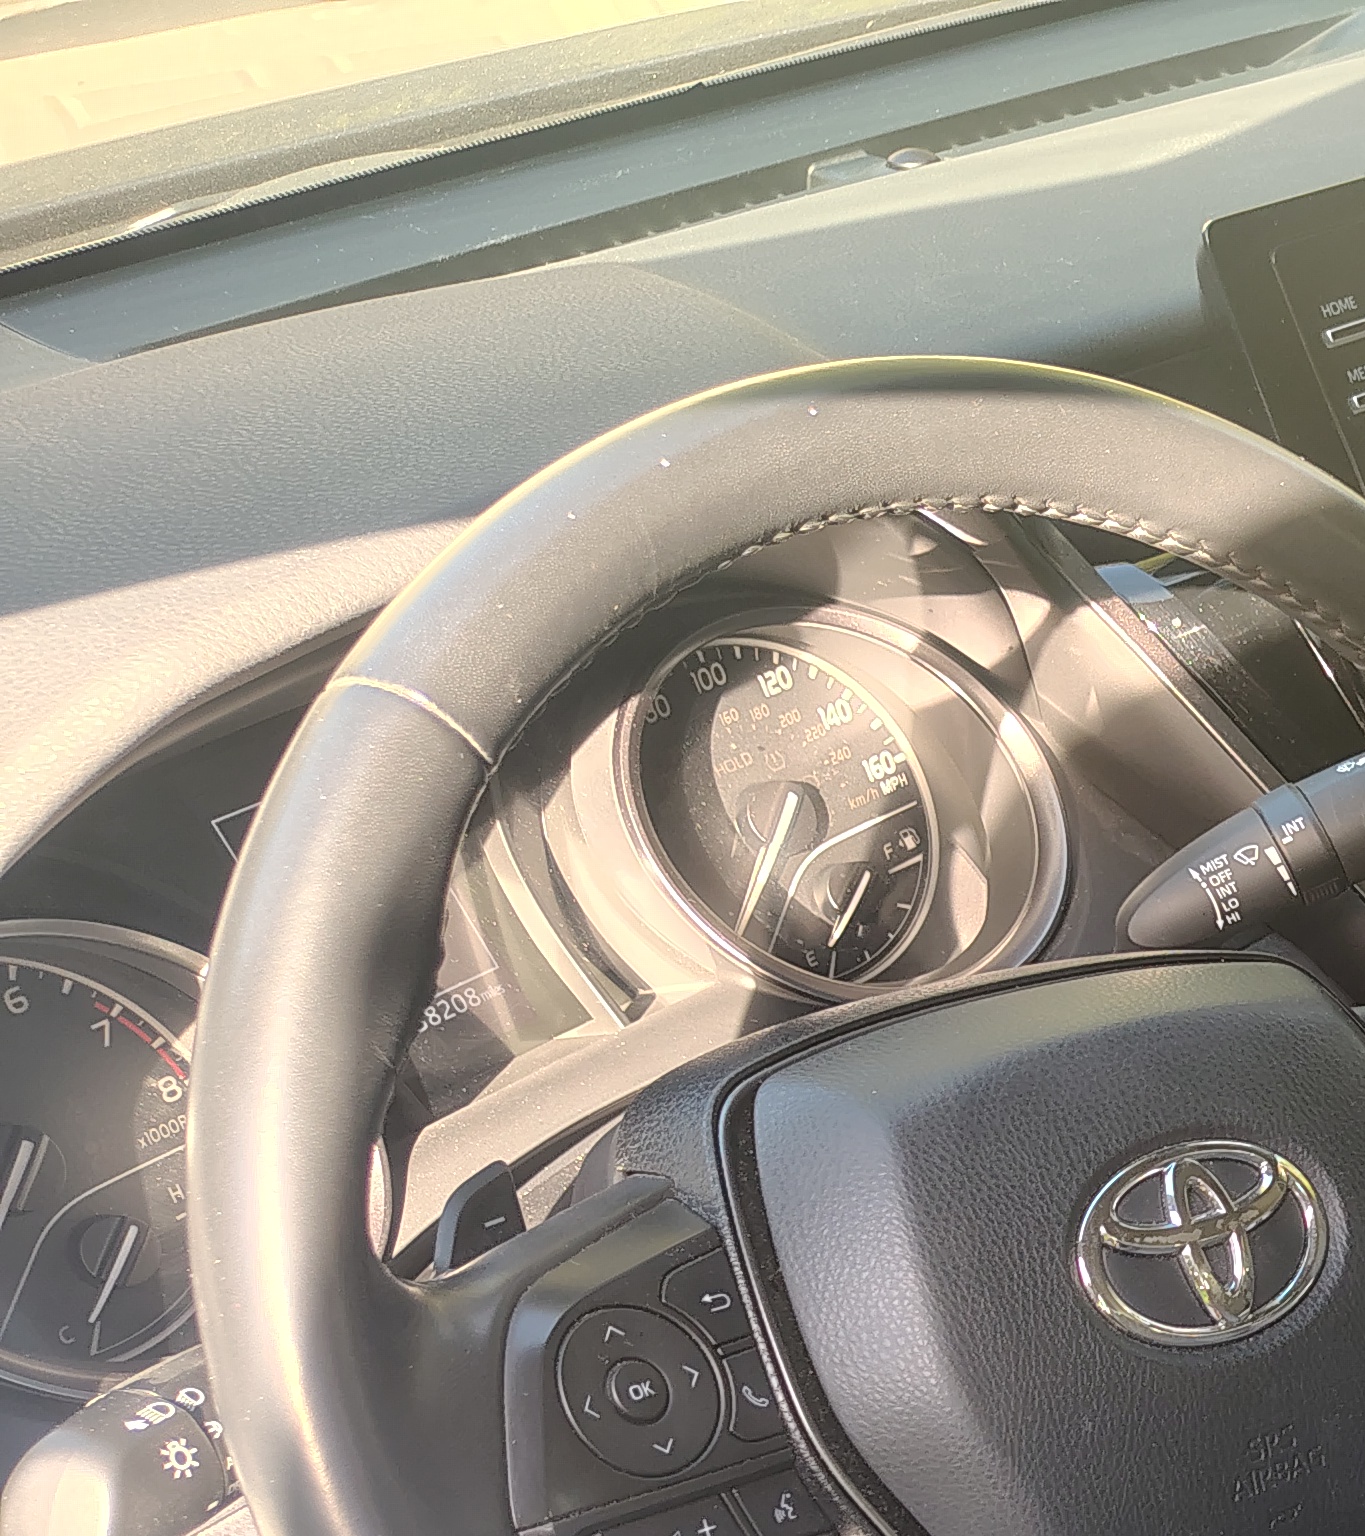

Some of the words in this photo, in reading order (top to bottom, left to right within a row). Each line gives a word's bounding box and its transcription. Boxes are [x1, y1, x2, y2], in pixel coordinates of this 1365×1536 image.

[1320, 295, 1358, 318] HOME
[690, 662, 727, 694] 100
[757, 665, 793, 697] 120
[718, 707, 740, 727] 160
[749, 703, 770, 723] 180
[778, 708, 801, 728] 200
[817, 699, 853, 730] 140
[714, 752, 753, 778] HOLD
[828, 746, 851, 766] 240
[861, 750, 897, 782] 160
[848, 786, 880, 809] km/h
[879, 774, 909, 796] MPH
[1283, 817, 1306, 837] INT
[883, 842, 894, 860] F
[1200, 854, 1229, 875] MIST
[1209, 869, 1233, 887] OFF
[1215, 881, 1238, 899] INT
[1223, 898, 1240, 912] LO
[1225, 912, 1242, 925] HI
[805, 950, 819, 967] E
[3, 985, 30, 1014] 6
[90, 1017, 111, 1048] 7
[157, 1075, 183, 1103] 8
[167, 1183, 186, 1204] H
[58, 1325, 76, 1345] C
[628, 1380, 656, 1402] OK
